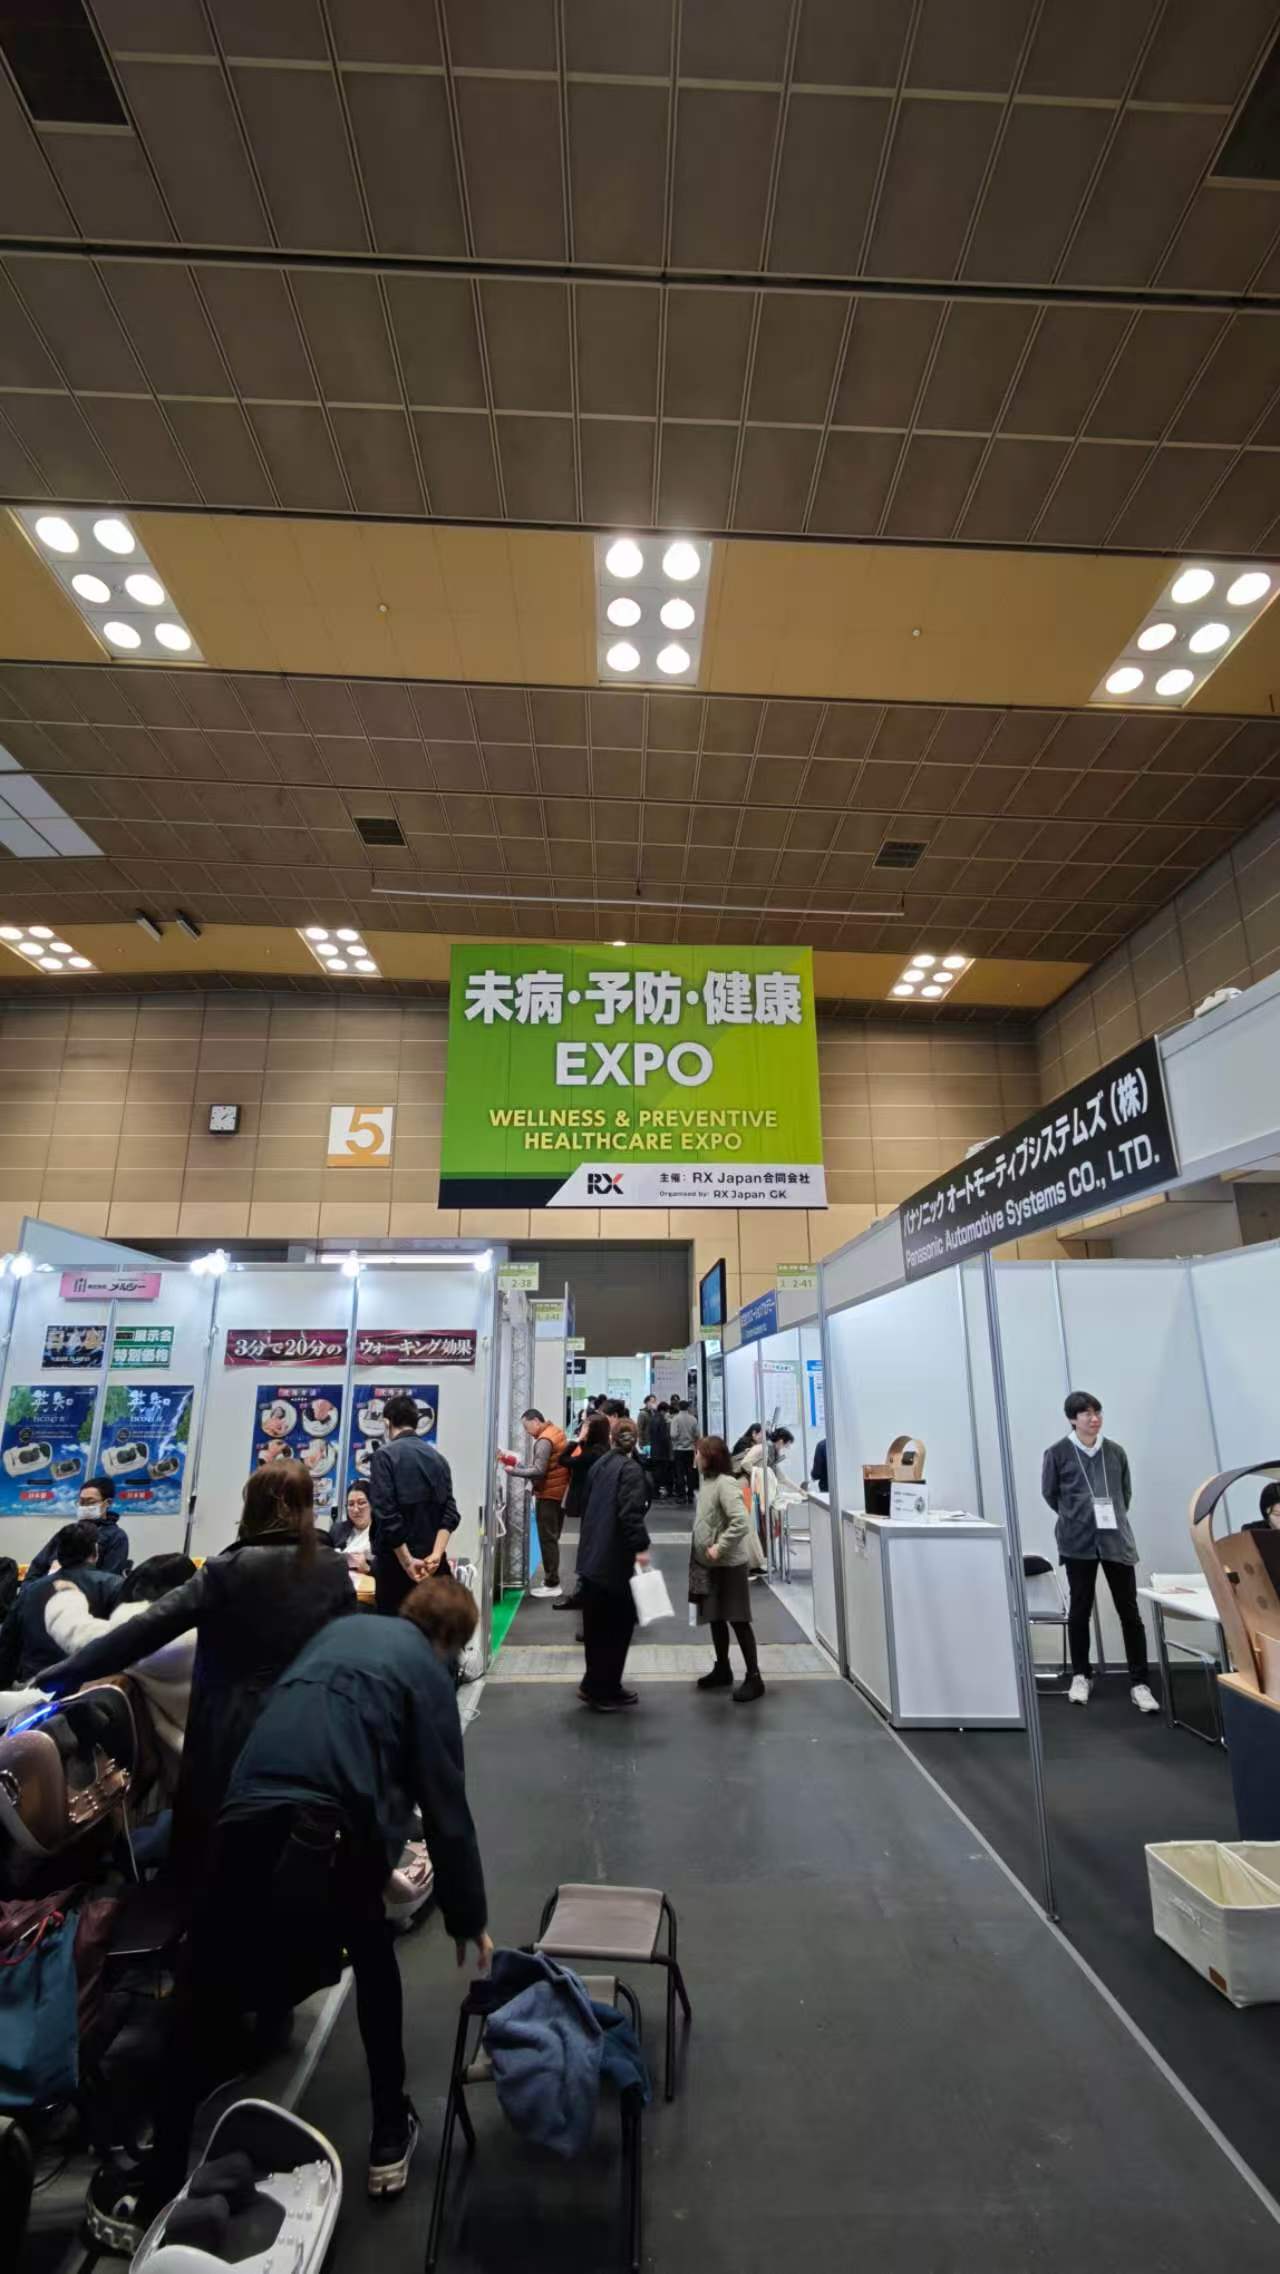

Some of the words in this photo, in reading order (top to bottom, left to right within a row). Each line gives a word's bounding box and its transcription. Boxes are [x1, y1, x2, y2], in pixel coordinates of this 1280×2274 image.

[464, 970, 802, 1025] 未病・予防・健康
[556, 1041, 714, 1087] EXPO
[489, 1109, 606, 1127] WELLNESS
[615, 1109, 631, 1127] &
[639, 1110, 778, 1128] PREVENTIVE
[346, 1105, 385, 1156] 5
[524, 1132, 673, 1150] HEALTHCARE
[681, 1133, 743, 1150] EXPO
[587, 1173, 624, 1195] RX
[693, 1172, 713, 1184] RX
[713, 1190, 729, 1199] RX
[731, 1190, 766, 1200] Japan
[770, 1190, 787, 1199] GK
[905, 1236, 944, 1269] Panasonic
[945, 1209, 1004, 1252] Automotive
[1006, 1181, 1067, 1226] Systems
[1068, 1160, 1106, 1197] CO.,
[1107, 1134, 1160, 1181] LTD.
[904, 1191, 945, 1236] パナソニック
[234, 1338, 343, 1357] 3分で20分の
[359, 1338, 473, 1356] ウォーキング効果
